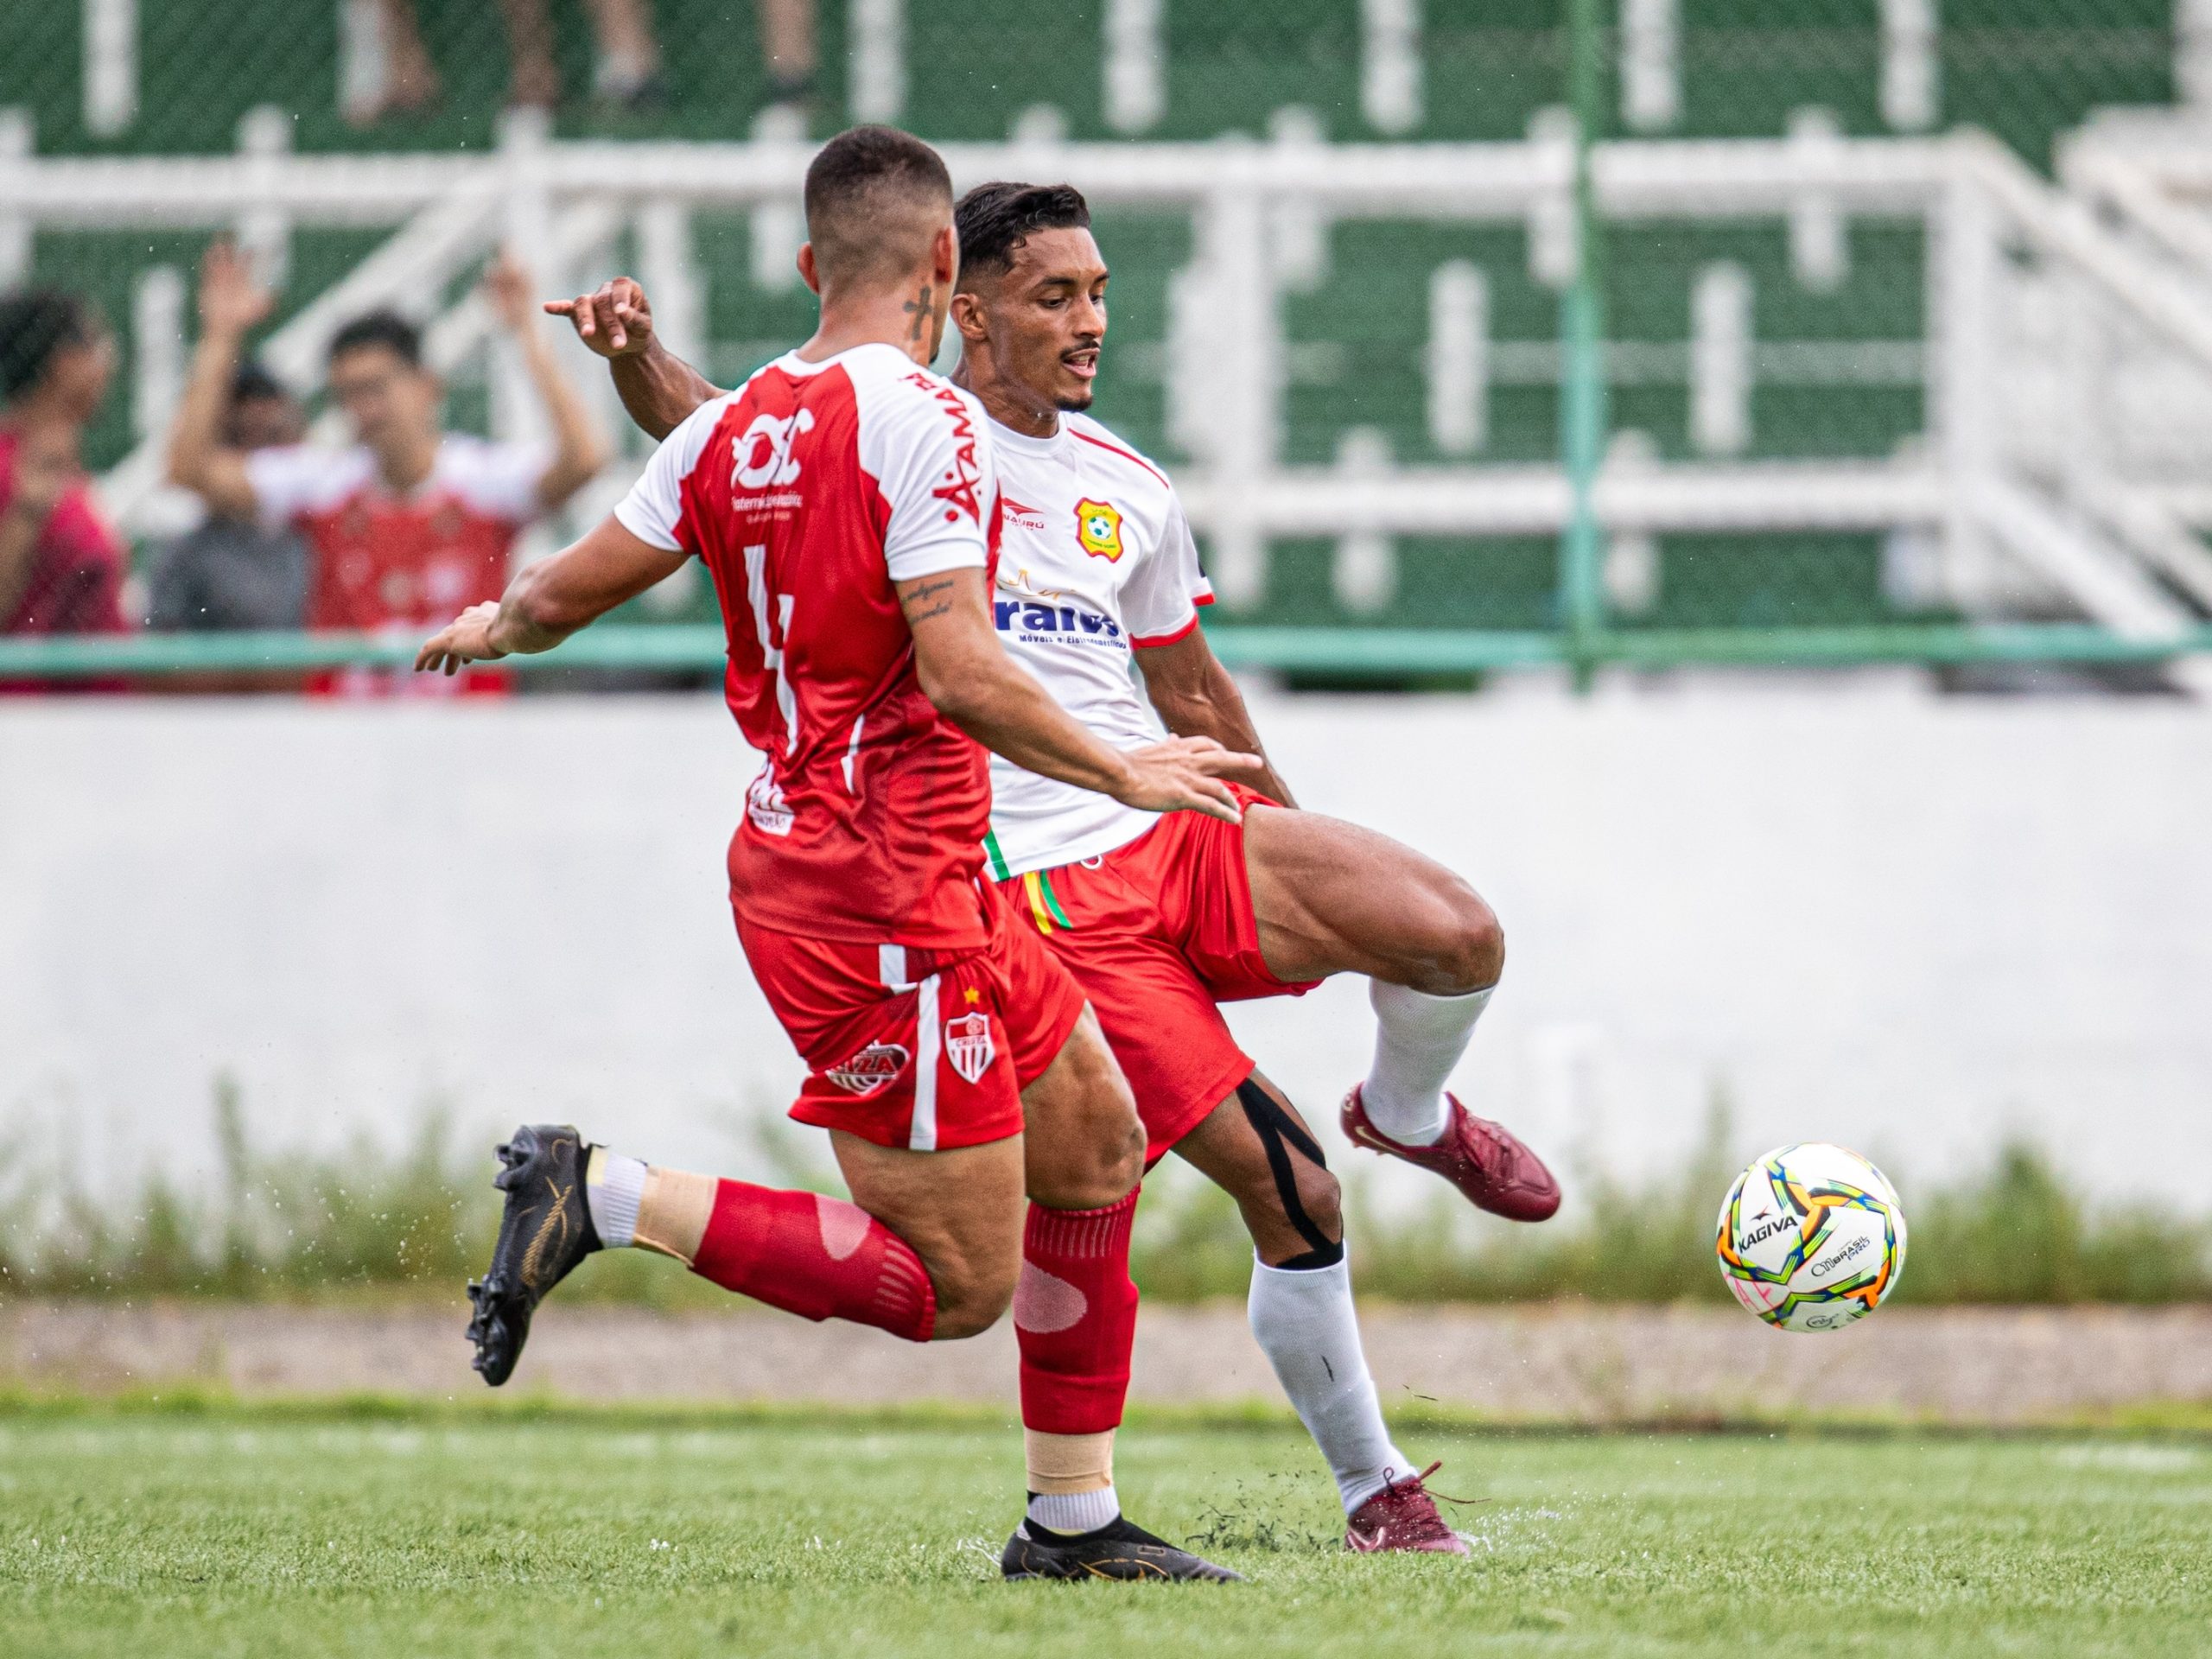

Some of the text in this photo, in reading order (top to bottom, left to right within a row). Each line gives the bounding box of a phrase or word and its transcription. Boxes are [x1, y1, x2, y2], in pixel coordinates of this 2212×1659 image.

[743, 543, 798, 758] 4
[1738, 1215, 1798, 1254] KAGIVA
[1833, 1236, 1869, 1265] BRASIL
[1847, 1239, 1871, 1261] PRO
